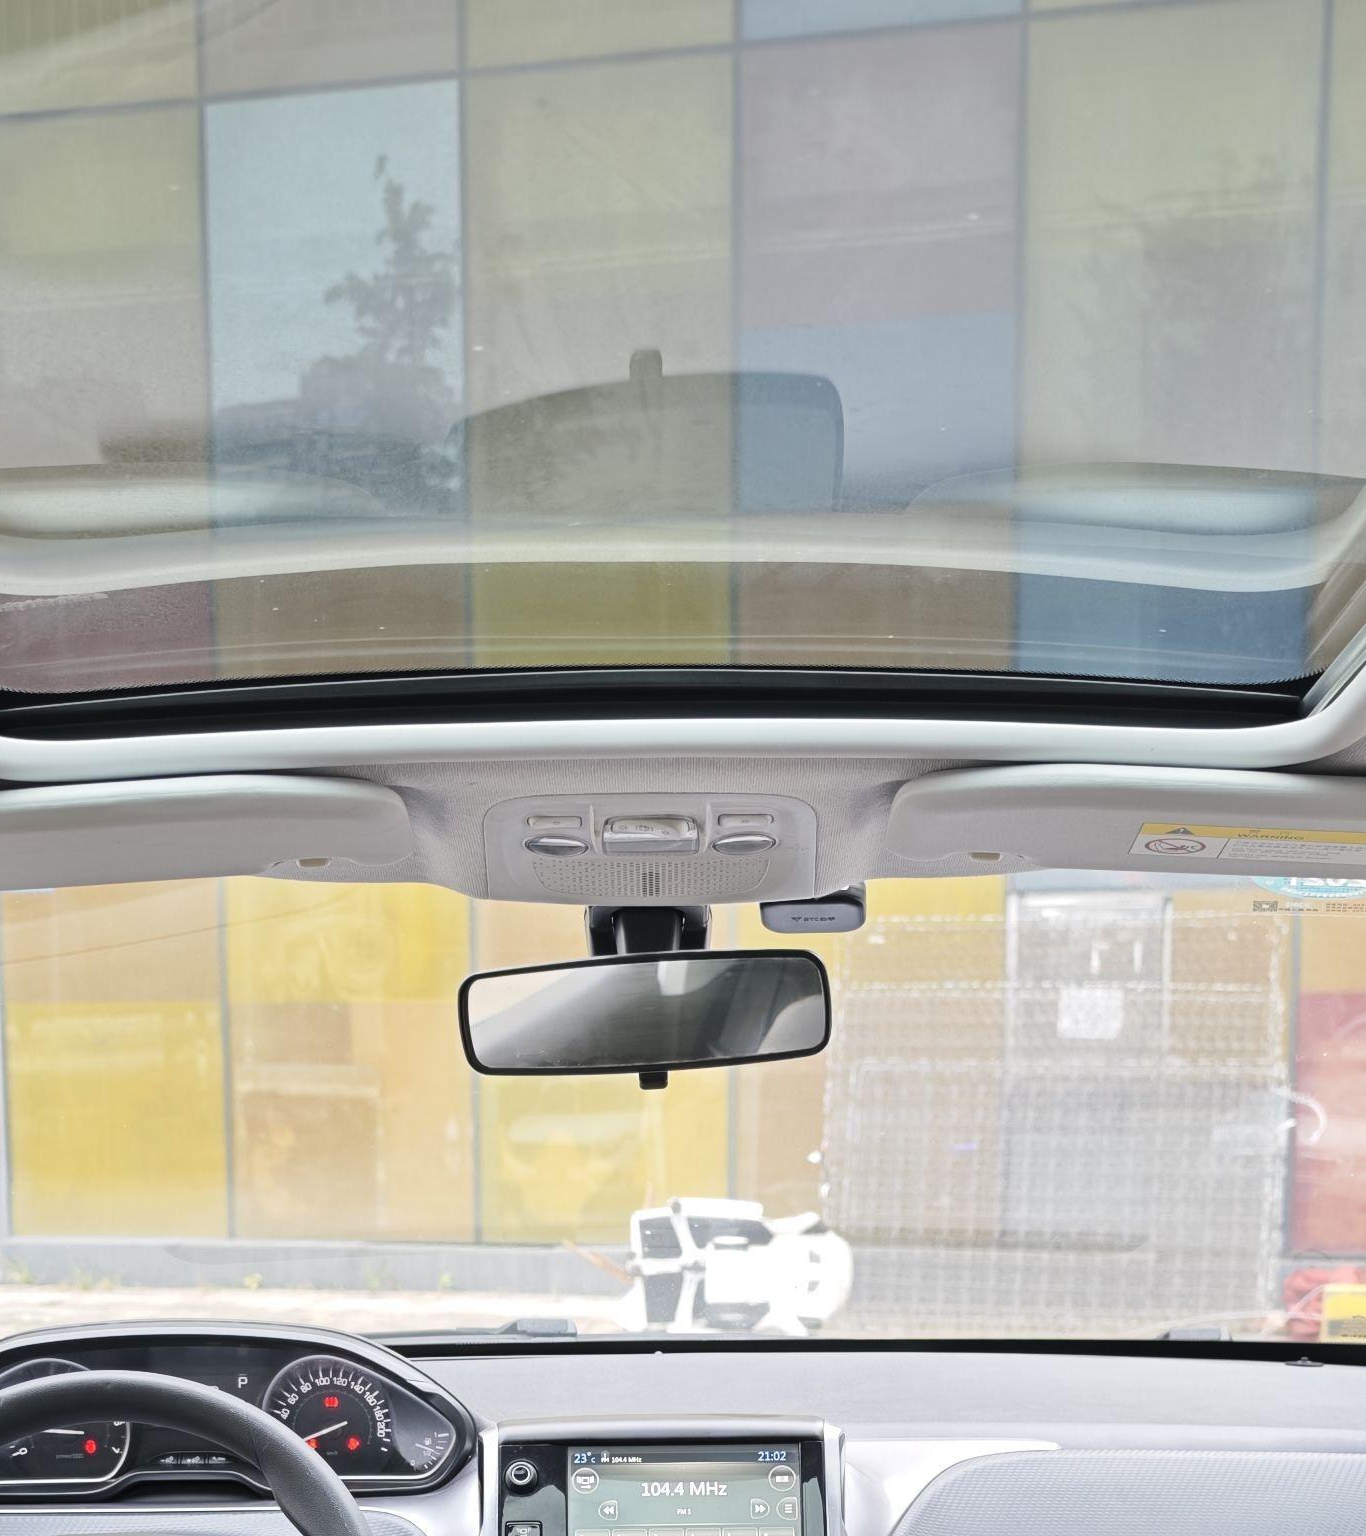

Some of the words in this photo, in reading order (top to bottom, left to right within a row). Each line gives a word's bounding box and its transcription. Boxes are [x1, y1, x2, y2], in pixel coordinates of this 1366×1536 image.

[238, 1377, 248, 1388] P
[315, 1377, 330, 1386] 100
[332, 1377, 348, 1386] 120
[300, 1382, 312, 1393] 80
[350, 1381, 364, 1394] 140
[287, 1393, 299, 1405] 60
[363, 1391, 377, 1406] 160
[374, 1406, 384, 1420] 180
[376, 1421, 385, 1438] 200
[611, 1456, 627, 1464] 104.4
[757, 1451, 787, 1462] 21:02
[641, 1481, 685, 1497] 104.4
[690, 1481, 728, 1496] MHz
